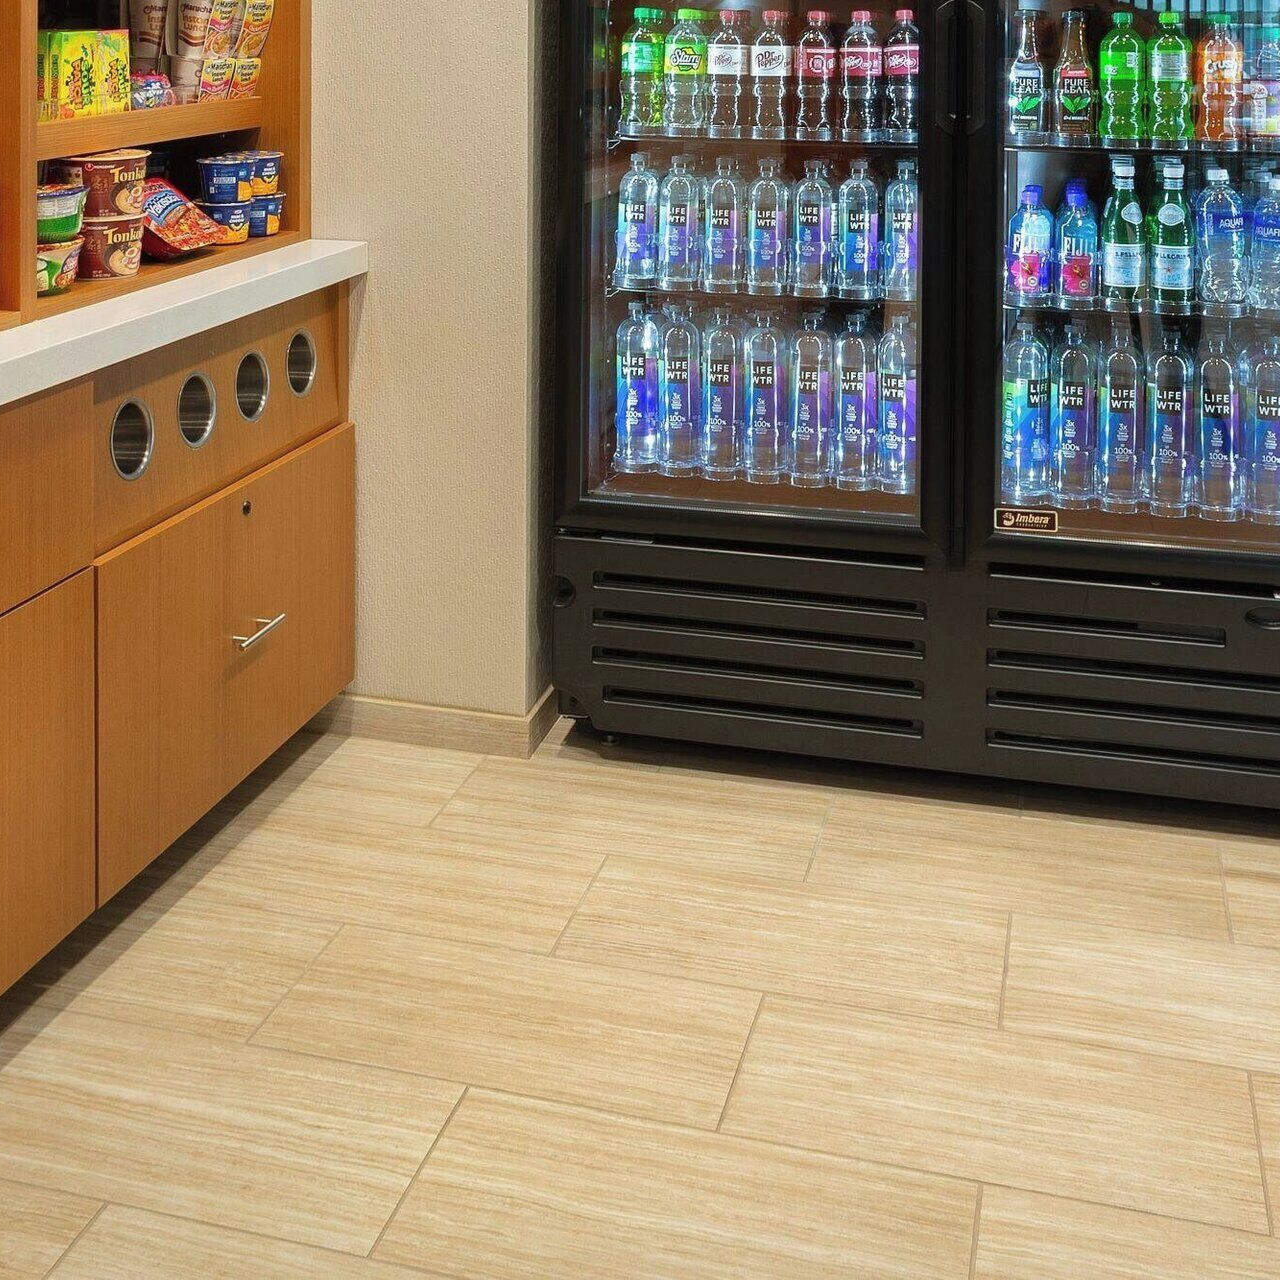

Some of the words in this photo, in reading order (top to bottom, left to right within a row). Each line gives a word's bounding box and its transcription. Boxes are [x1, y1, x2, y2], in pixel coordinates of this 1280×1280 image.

[671, 49, 702, 69] Starry
[756, 55, 782, 69] Pepper
[1014, 78, 1038, 87] PURE
[1064, 78, 1089, 87] PURE
[757, 210, 776, 218] LIFE
[800, 206, 818, 214] LIFE
[757, 219, 776, 227] WTR
[800, 215, 818, 223] WTR
[1064, 236, 1088, 257] FIJI
[622, 357, 644, 366] LIFE
[666, 361, 688, 370] LIFE
[622, 367, 644, 376] WTR
[667, 372, 688, 380] WTR
[882, 378, 904, 388] LIFE
[882, 389, 904, 398] WTR
[1059, 386, 1084, 395] LIFE
[1111, 388, 1136, 398] LIFE
[1156, 391, 1182, 400] LIFE
[1204, 393, 1230, 403] LIFE
[1058, 396, 1084, 406] WTR
[1111, 400, 1136, 410] WTR
[1156, 402, 1182, 411] WTR
[1204, 405, 1230, 414] WTR
[1015, 513, 1050, 525] Imbera
